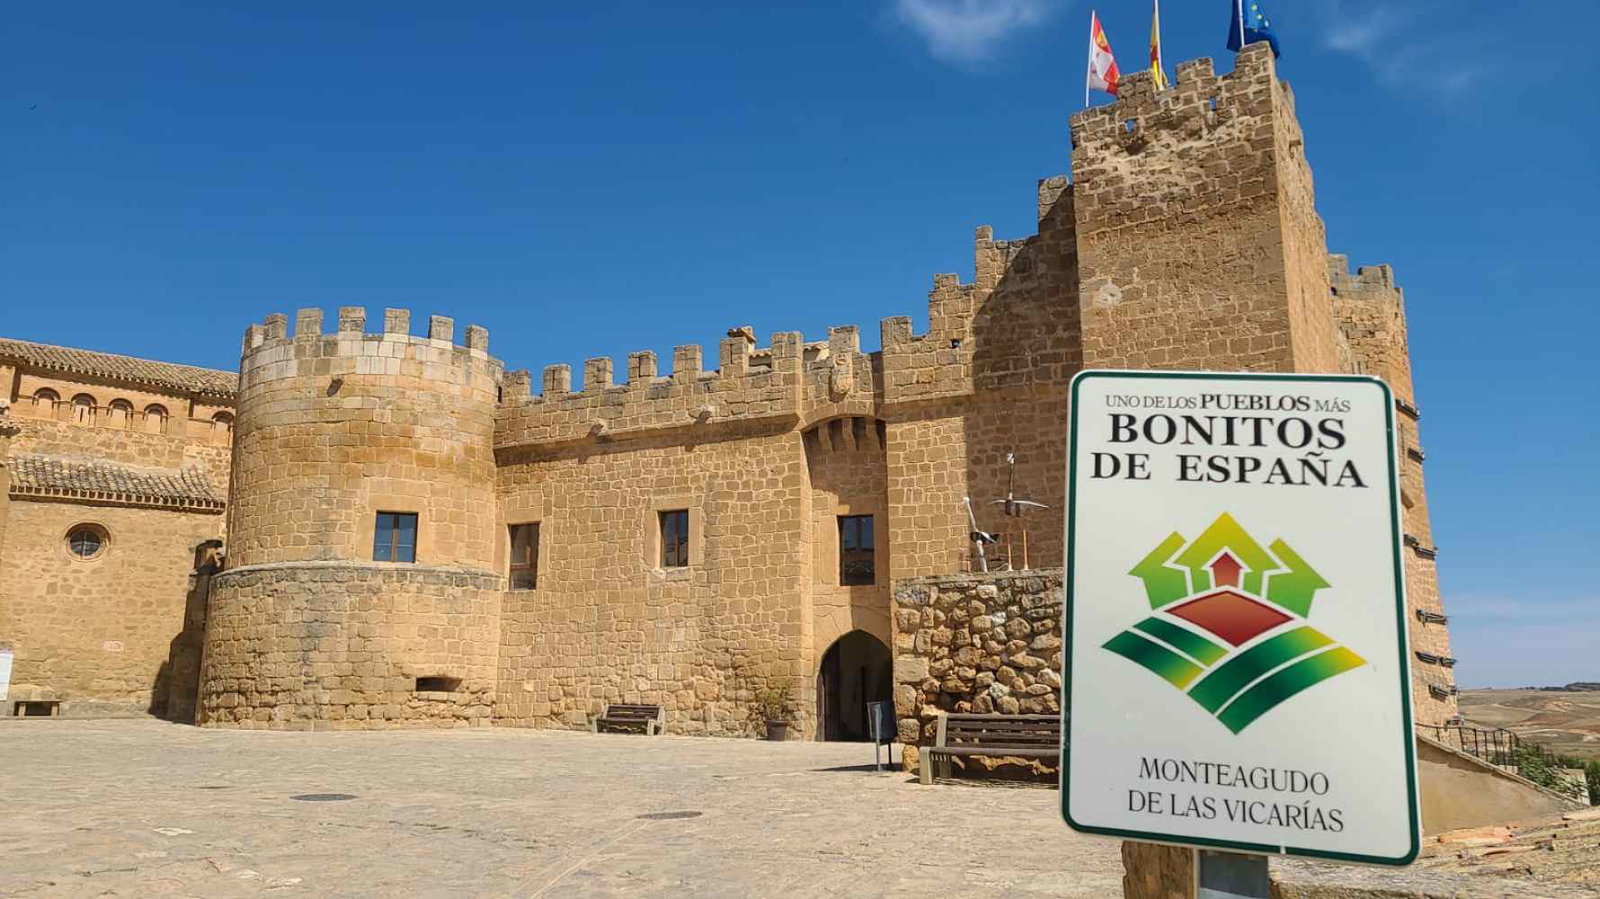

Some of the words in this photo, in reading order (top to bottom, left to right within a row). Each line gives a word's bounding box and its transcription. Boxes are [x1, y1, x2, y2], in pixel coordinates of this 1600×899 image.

[1105, 394, 1140, 408] UNO
[1143, 395, 1165, 409] DE
[1166, 396, 1197, 409] LOS
[1199, 393, 1311, 412] PUEBLOS
[1314, 397, 1351, 413] MÁS
[1107, 413, 1346, 450] BONITOS
[1090, 452, 1151, 480] DE
[1175, 451, 1370, 488] ESPAÑA
[1138, 757, 1330, 795] MONTEAGUDO
[1128, 789, 1163, 815] DE
[1170, 794, 1217, 819] LAS
[1223, 798, 1345, 833] VICARÍAS
